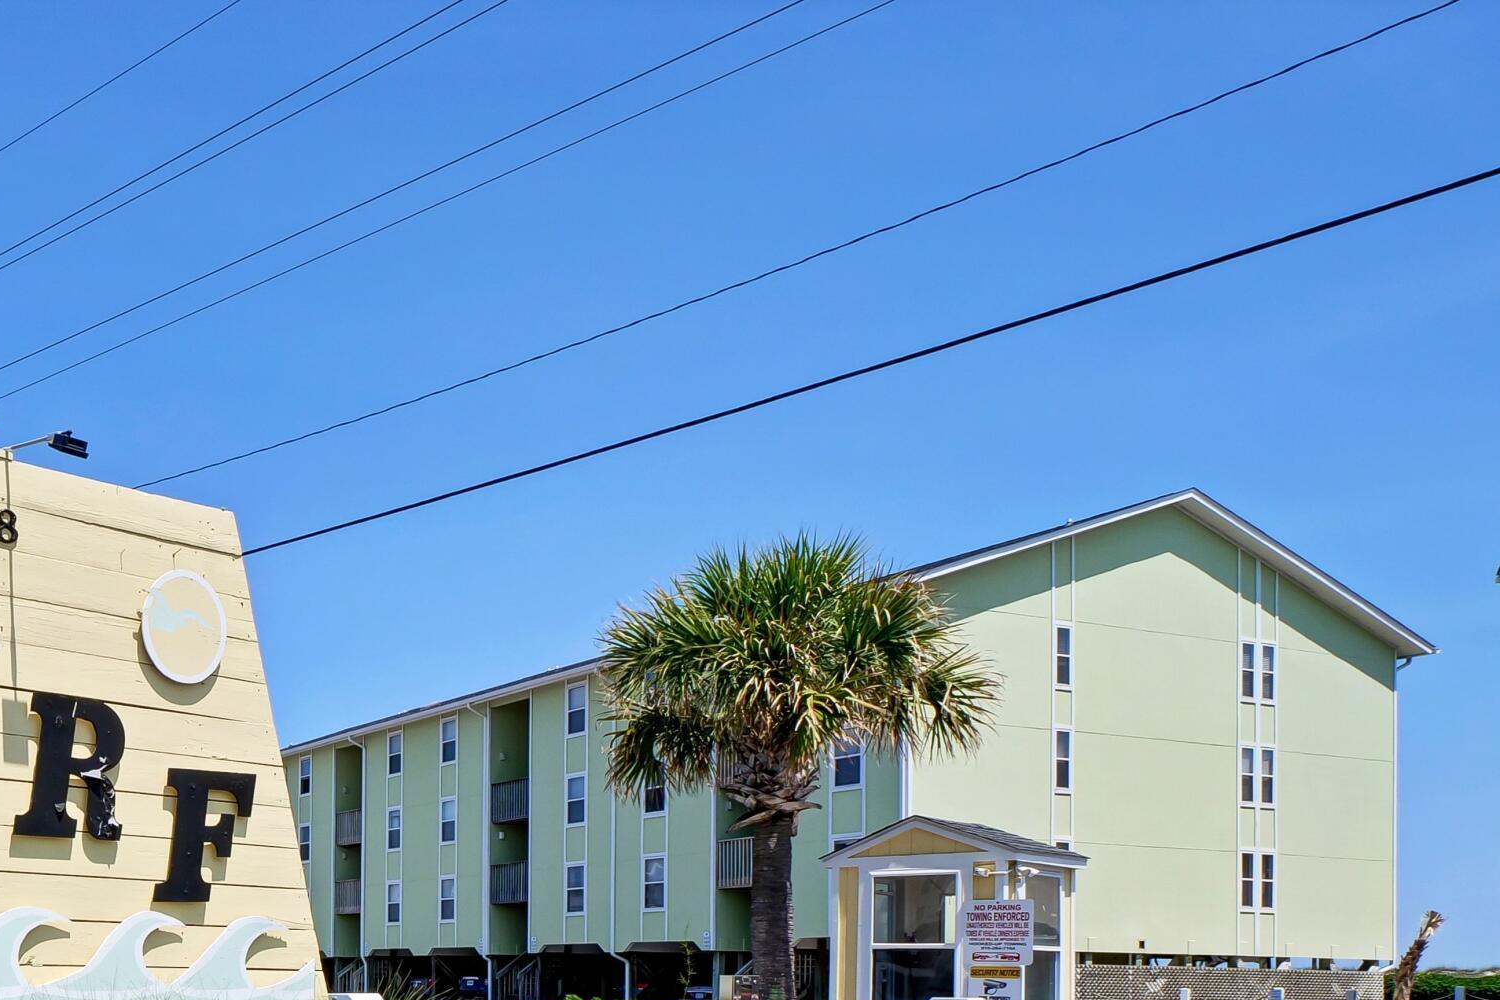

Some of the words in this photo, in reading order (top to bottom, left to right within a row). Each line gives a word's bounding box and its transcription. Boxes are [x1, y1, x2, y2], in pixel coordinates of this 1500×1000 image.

[966, 912, 993, 921] TOWING
[994, 912, 1030, 921] ENFORCED
[999, 969, 1021, 977] NOTICE
